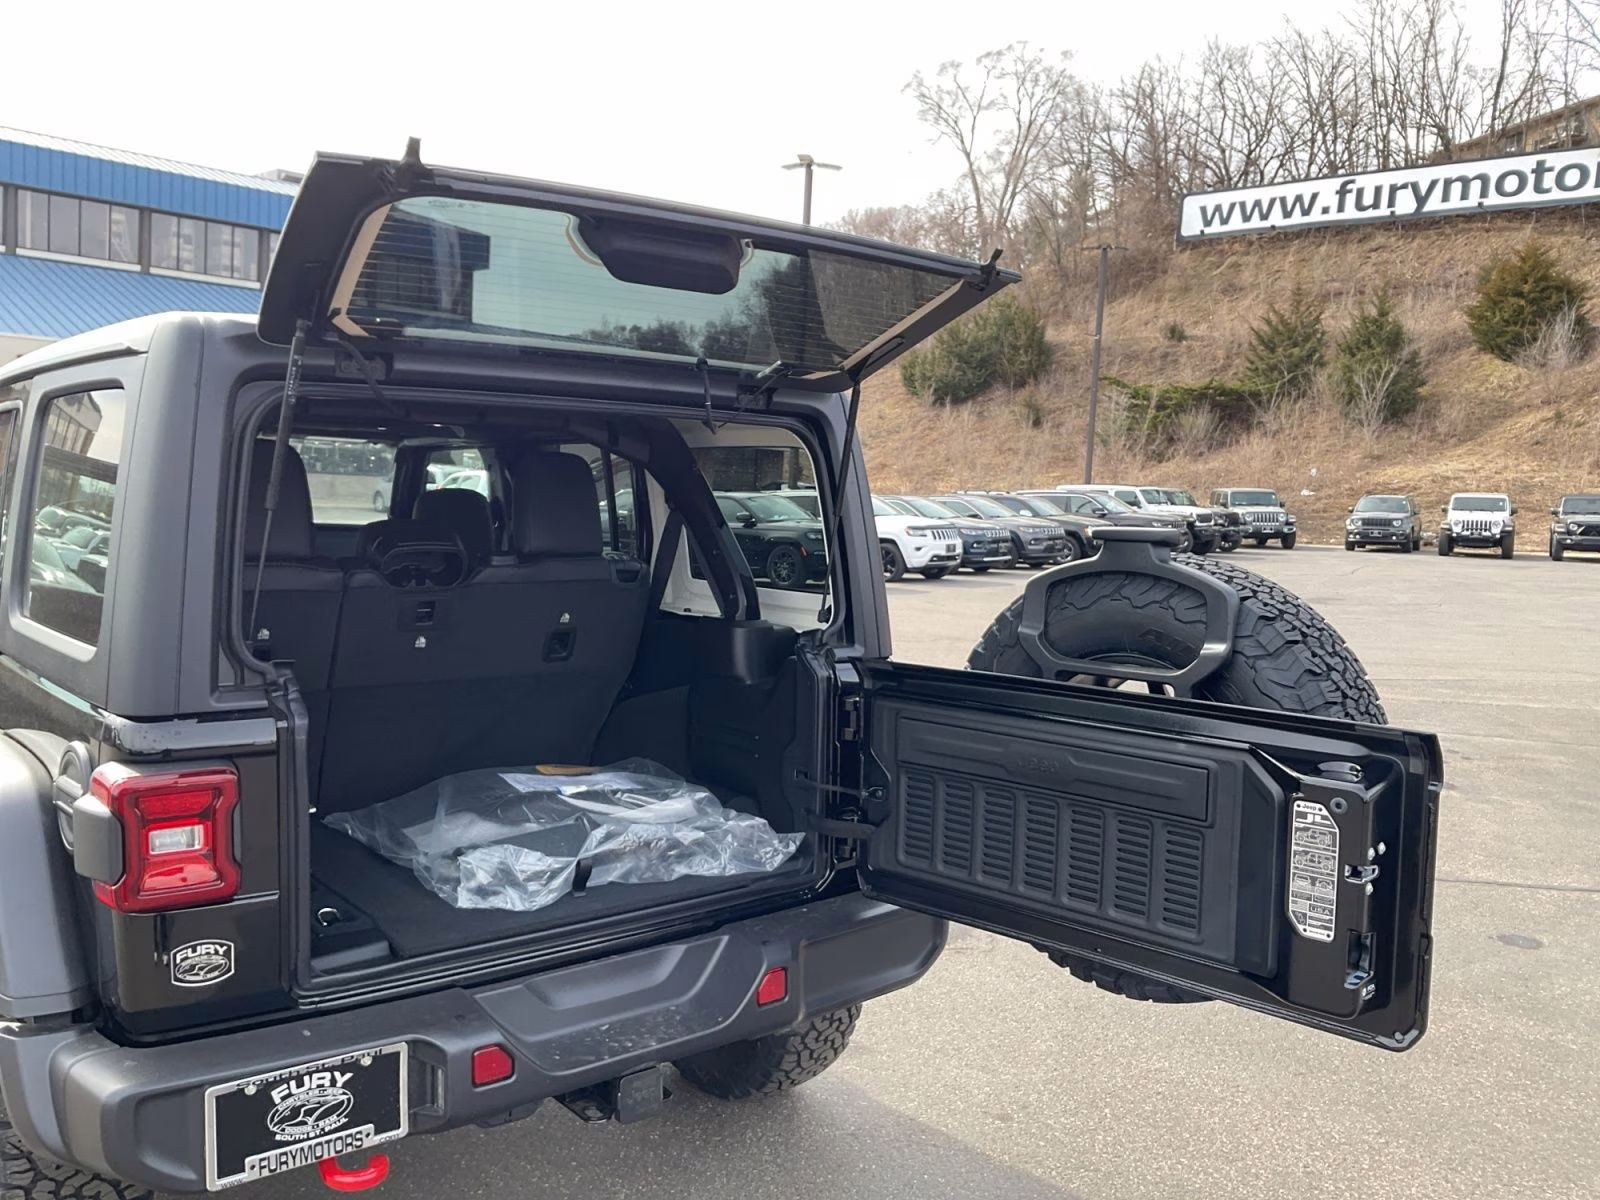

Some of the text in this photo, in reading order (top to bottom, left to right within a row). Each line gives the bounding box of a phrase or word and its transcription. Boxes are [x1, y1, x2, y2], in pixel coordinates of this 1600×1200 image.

[176, 944, 228, 964] FURY
[271, 1071, 354, 1105] FURY
[275, 1133, 308, 1141] SOUTH
[324, 1117, 349, 1132] PAUL
[259, 1130, 364, 1176] FURYMOTORS
